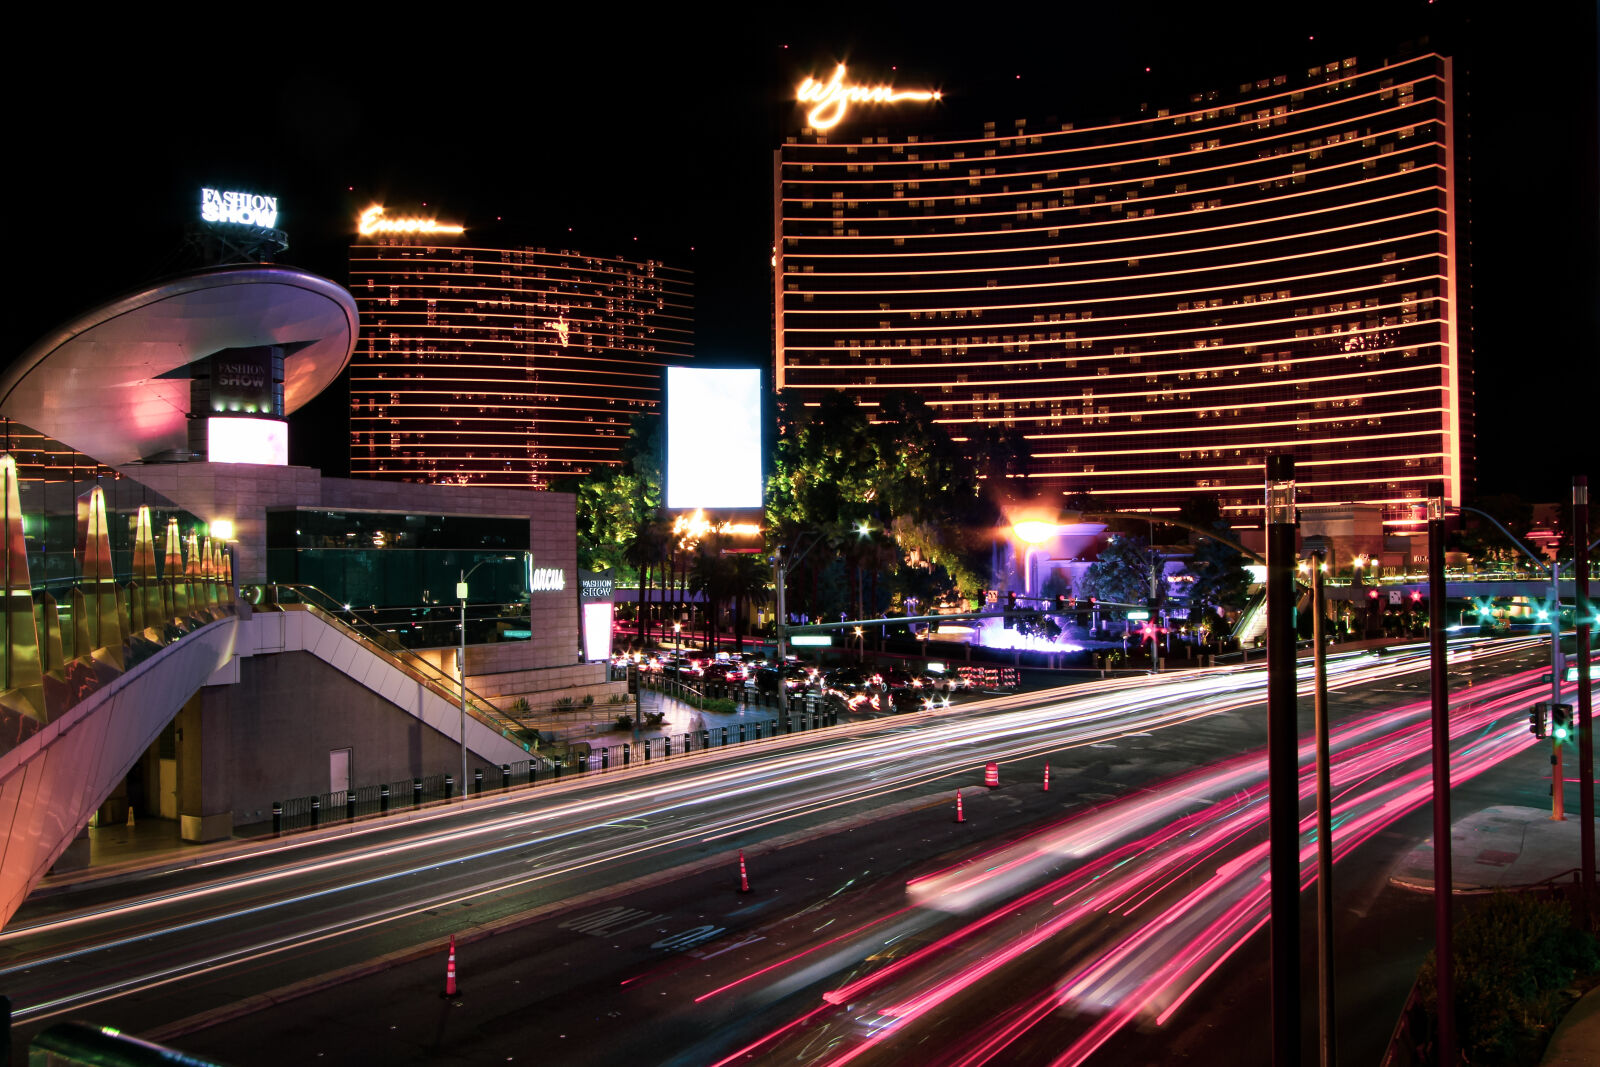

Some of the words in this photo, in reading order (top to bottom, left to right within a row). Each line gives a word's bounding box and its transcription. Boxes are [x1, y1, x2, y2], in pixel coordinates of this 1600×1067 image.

[201, 188, 277, 211] FASHION
[201, 203, 278, 228] SHOW
[359, 205, 465, 235] Encore
[217, 362, 264, 375] FASHION
[219, 374, 264, 387] SHOW
[582, 579, 612, 588] FASHION
[582, 587, 611, 597] SHOW
